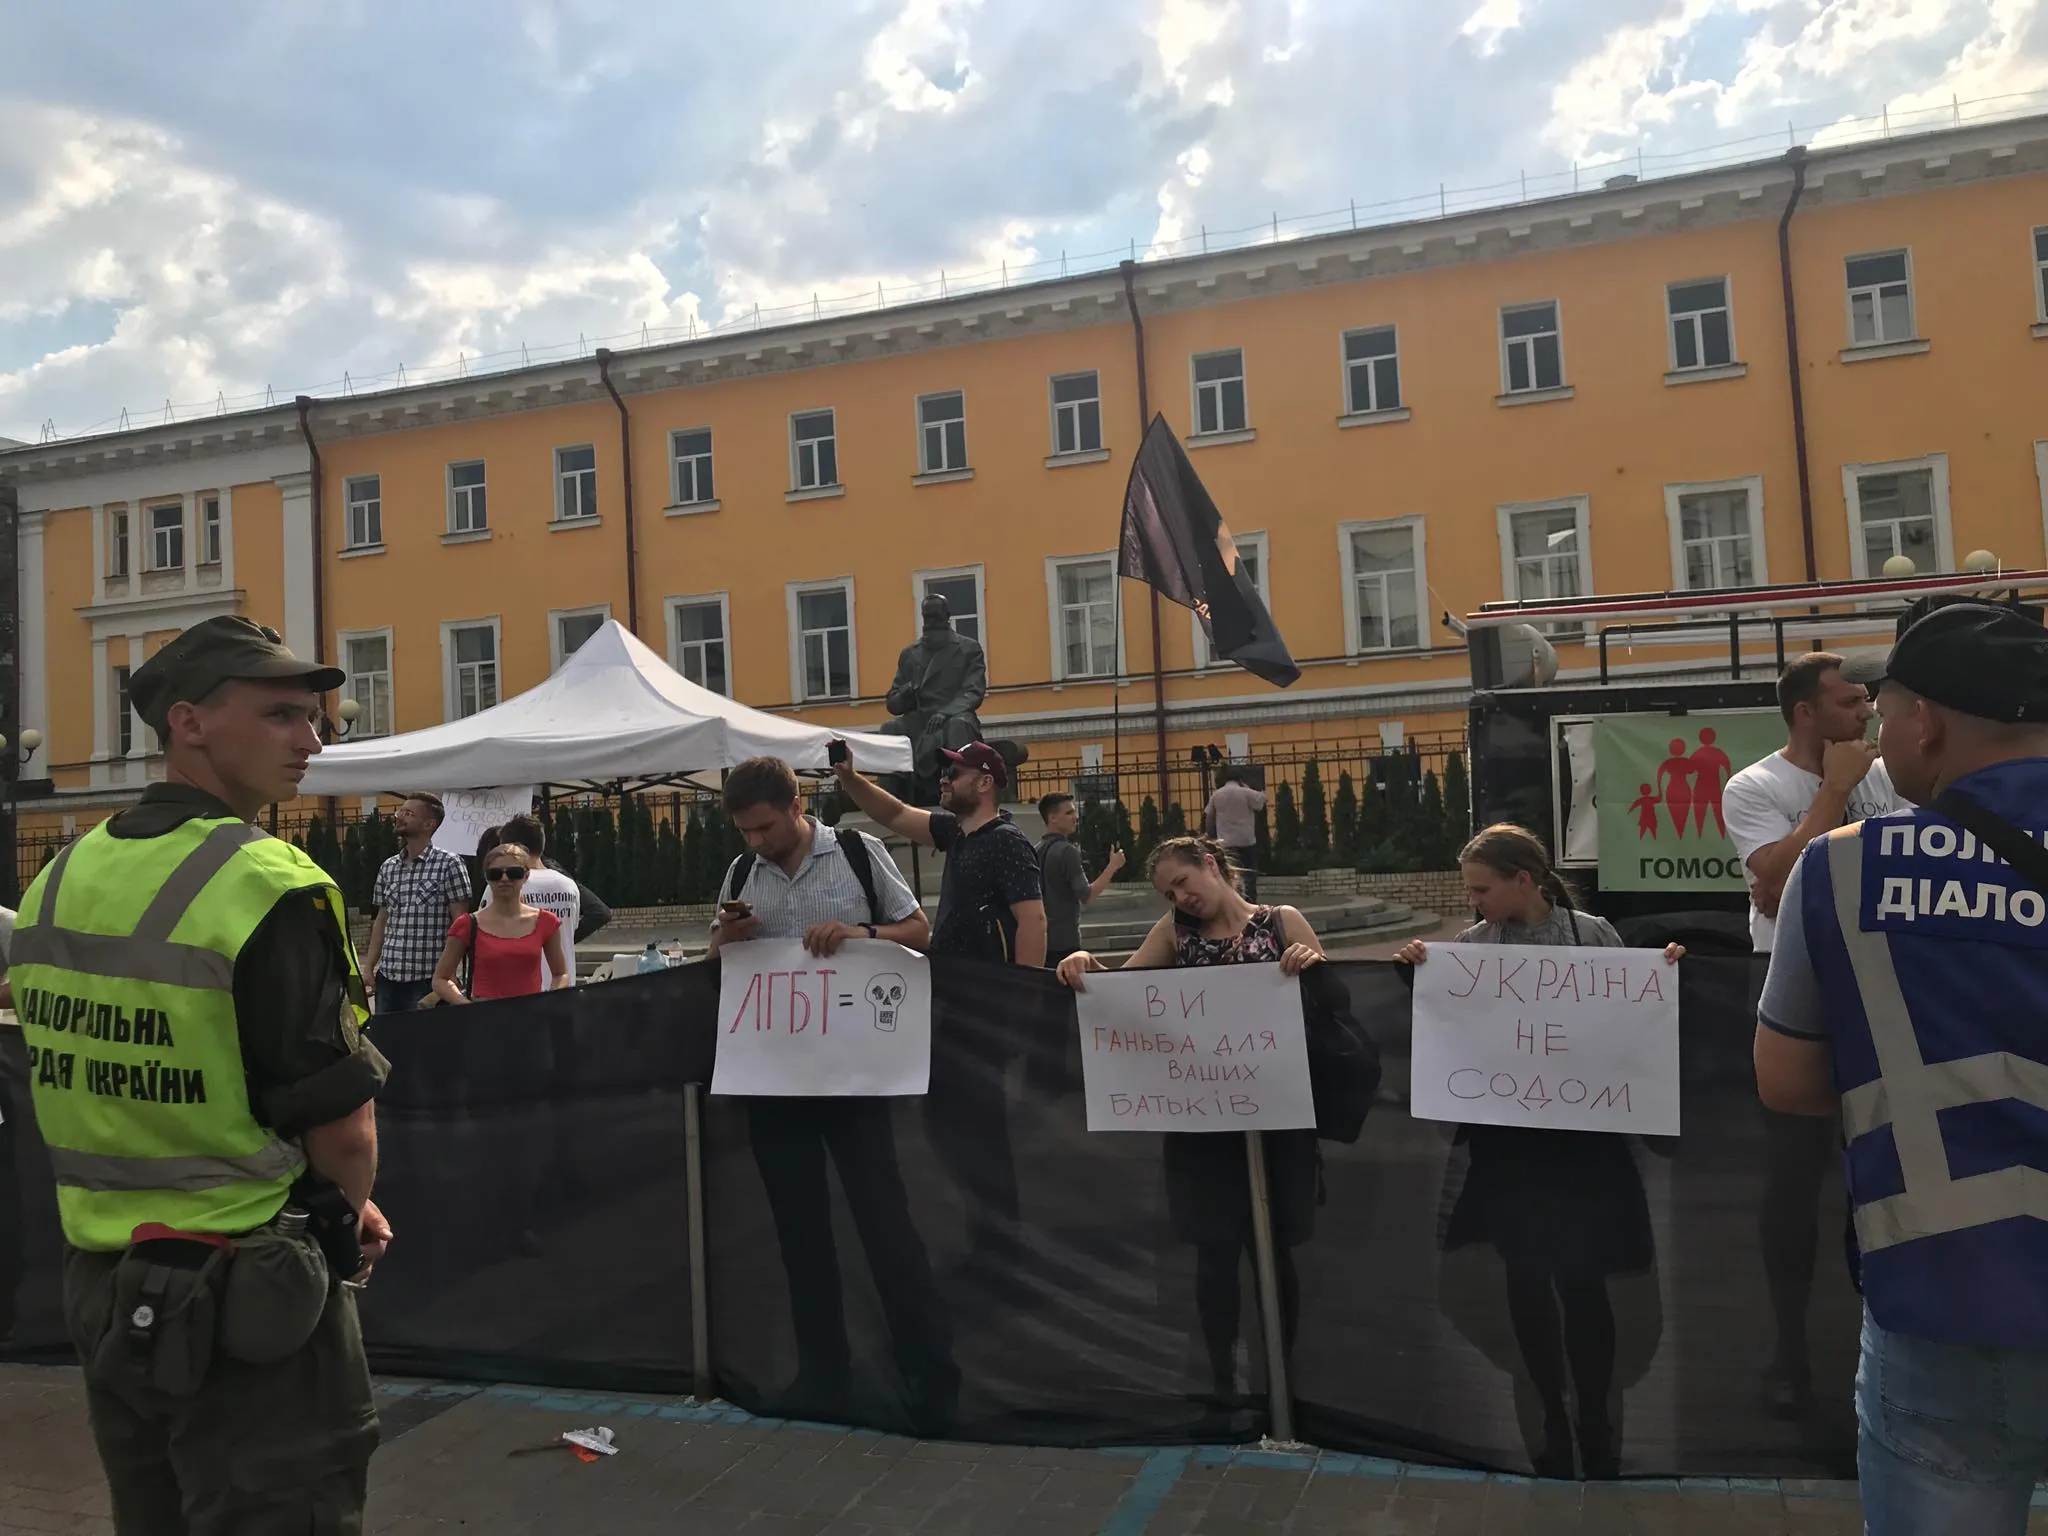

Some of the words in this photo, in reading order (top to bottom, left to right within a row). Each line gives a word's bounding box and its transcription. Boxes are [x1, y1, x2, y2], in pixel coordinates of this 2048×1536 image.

[1639, 858, 1743, 879] ГОМОС
[1876, 877, 2046, 927] ДІАЛО
[1447, 951, 1665, 1004] УКРАЇНА
[1145, 984, 1206, 1018] ВИ
[1094, 1027, 1196, 1054] ГАНЬБА
[1213, 1030, 1277, 1056] ДЛЯ
[1517, 1018, 1569, 1056] НЕ
[1168, 1059, 1260, 1082] ВАШИХ
[1109, 1089, 1260, 1117] БАТЬКІВ
[1447, 1068, 1632, 1113] СОДОМ
